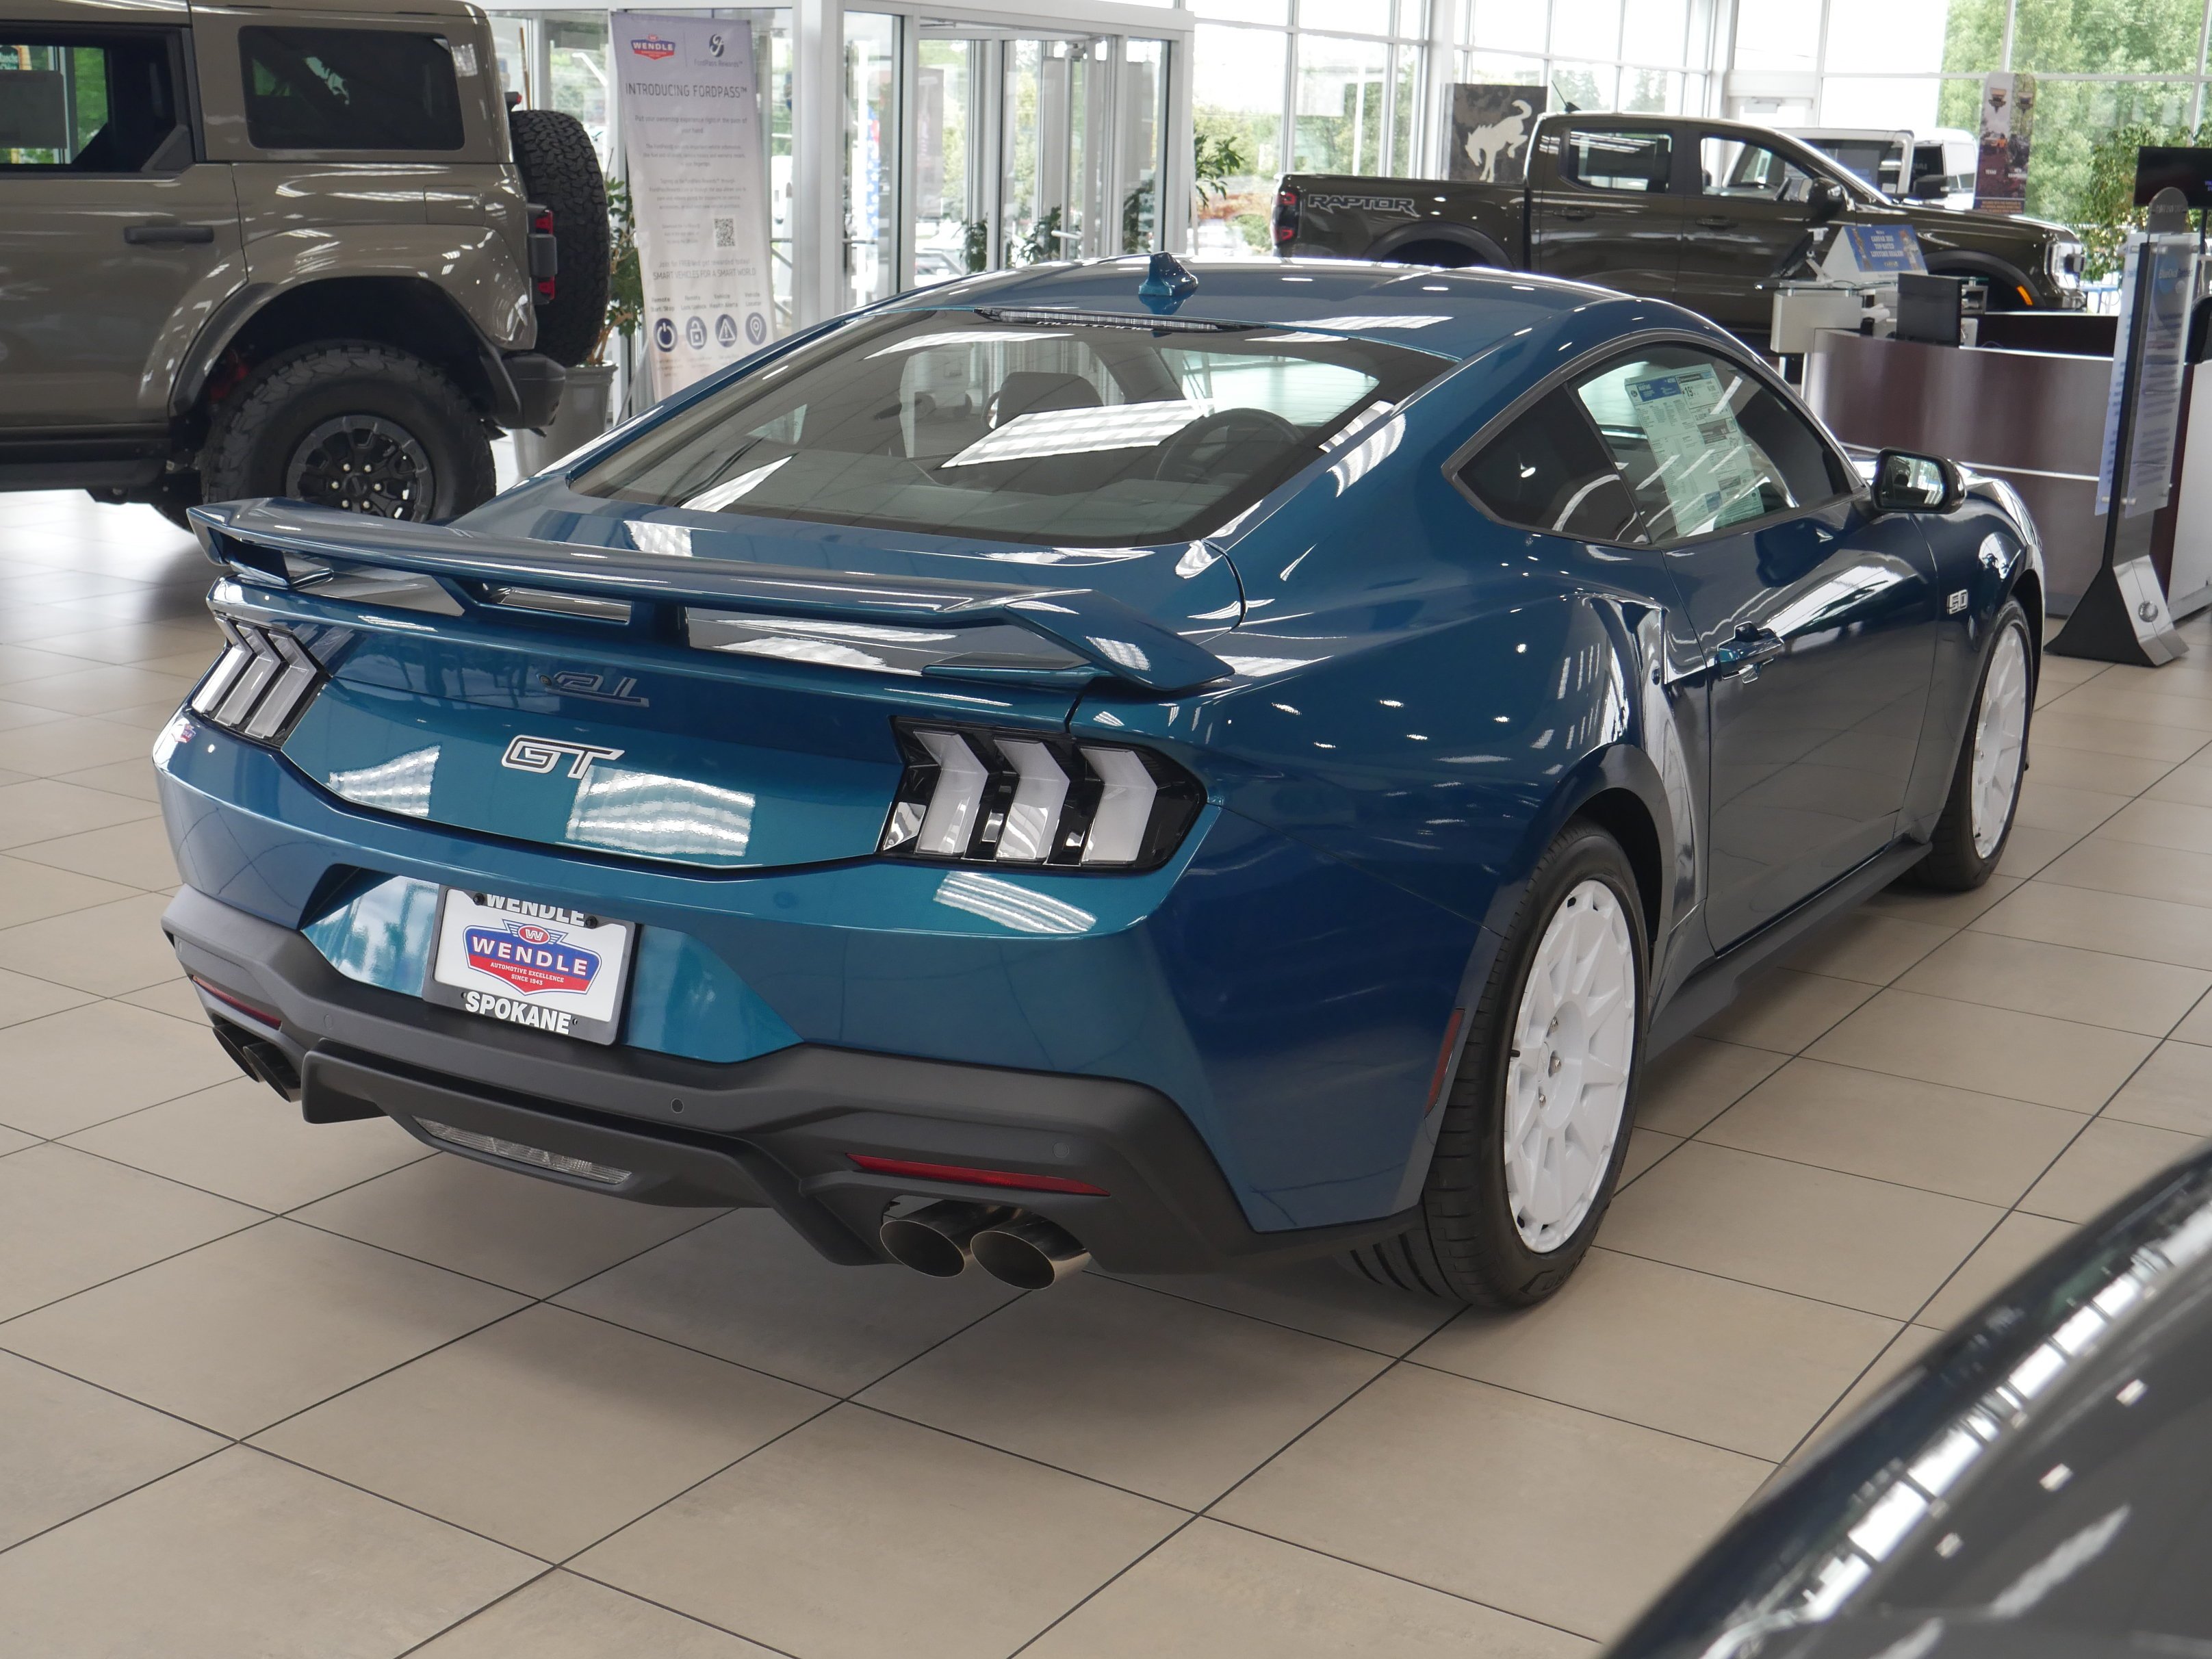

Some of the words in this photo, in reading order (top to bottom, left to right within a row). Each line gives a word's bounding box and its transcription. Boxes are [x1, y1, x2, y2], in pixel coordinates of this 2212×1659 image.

[632, 42, 673, 51] WENDLE
[626, 83, 690, 97] INTRODUCING
[1308, 194, 1421, 218] RAPTOR
[653, 271, 673, 281] SMART
[675, 270, 699, 279] VEHICLES
[700, 270, 711, 278] FOR
[717, 268, 737, 277] SMART
[737, 268, 756, 276] WORLD
[502, 734, 625, 780] GT
[487, 893, 586, 927] WENDLE
[472, 936, 588, 977] WENDLE
[490, 962, 527, 975] AUTOMOTIVE
[528, 970, 565, 983] EXCELLENCE
[511, 974, 528, 983] SINCE
[465, 991, 571, 1036] SPOKANE
